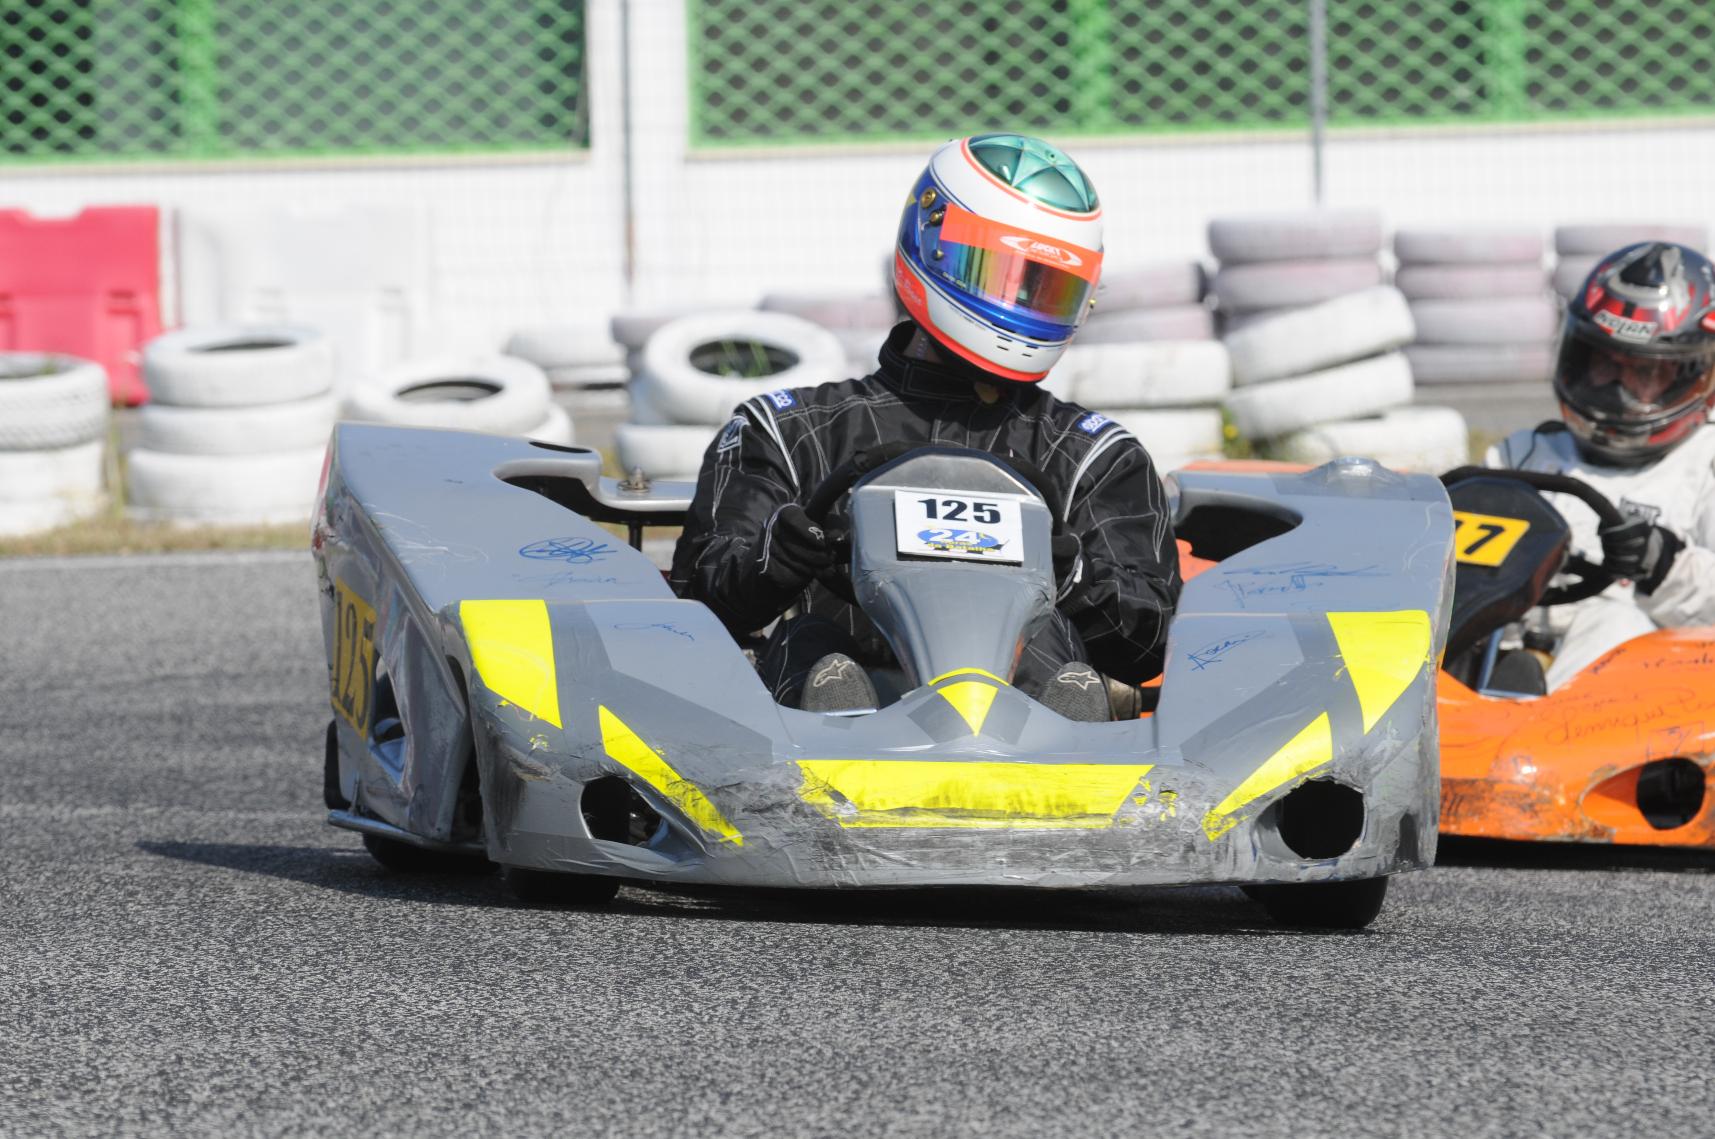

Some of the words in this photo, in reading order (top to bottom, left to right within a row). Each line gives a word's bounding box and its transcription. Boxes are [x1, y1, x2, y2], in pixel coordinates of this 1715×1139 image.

[917, 498, 1001, 525] 125
[928, 529, 979, 545] 24
[333, 591, 375, 729] 125
